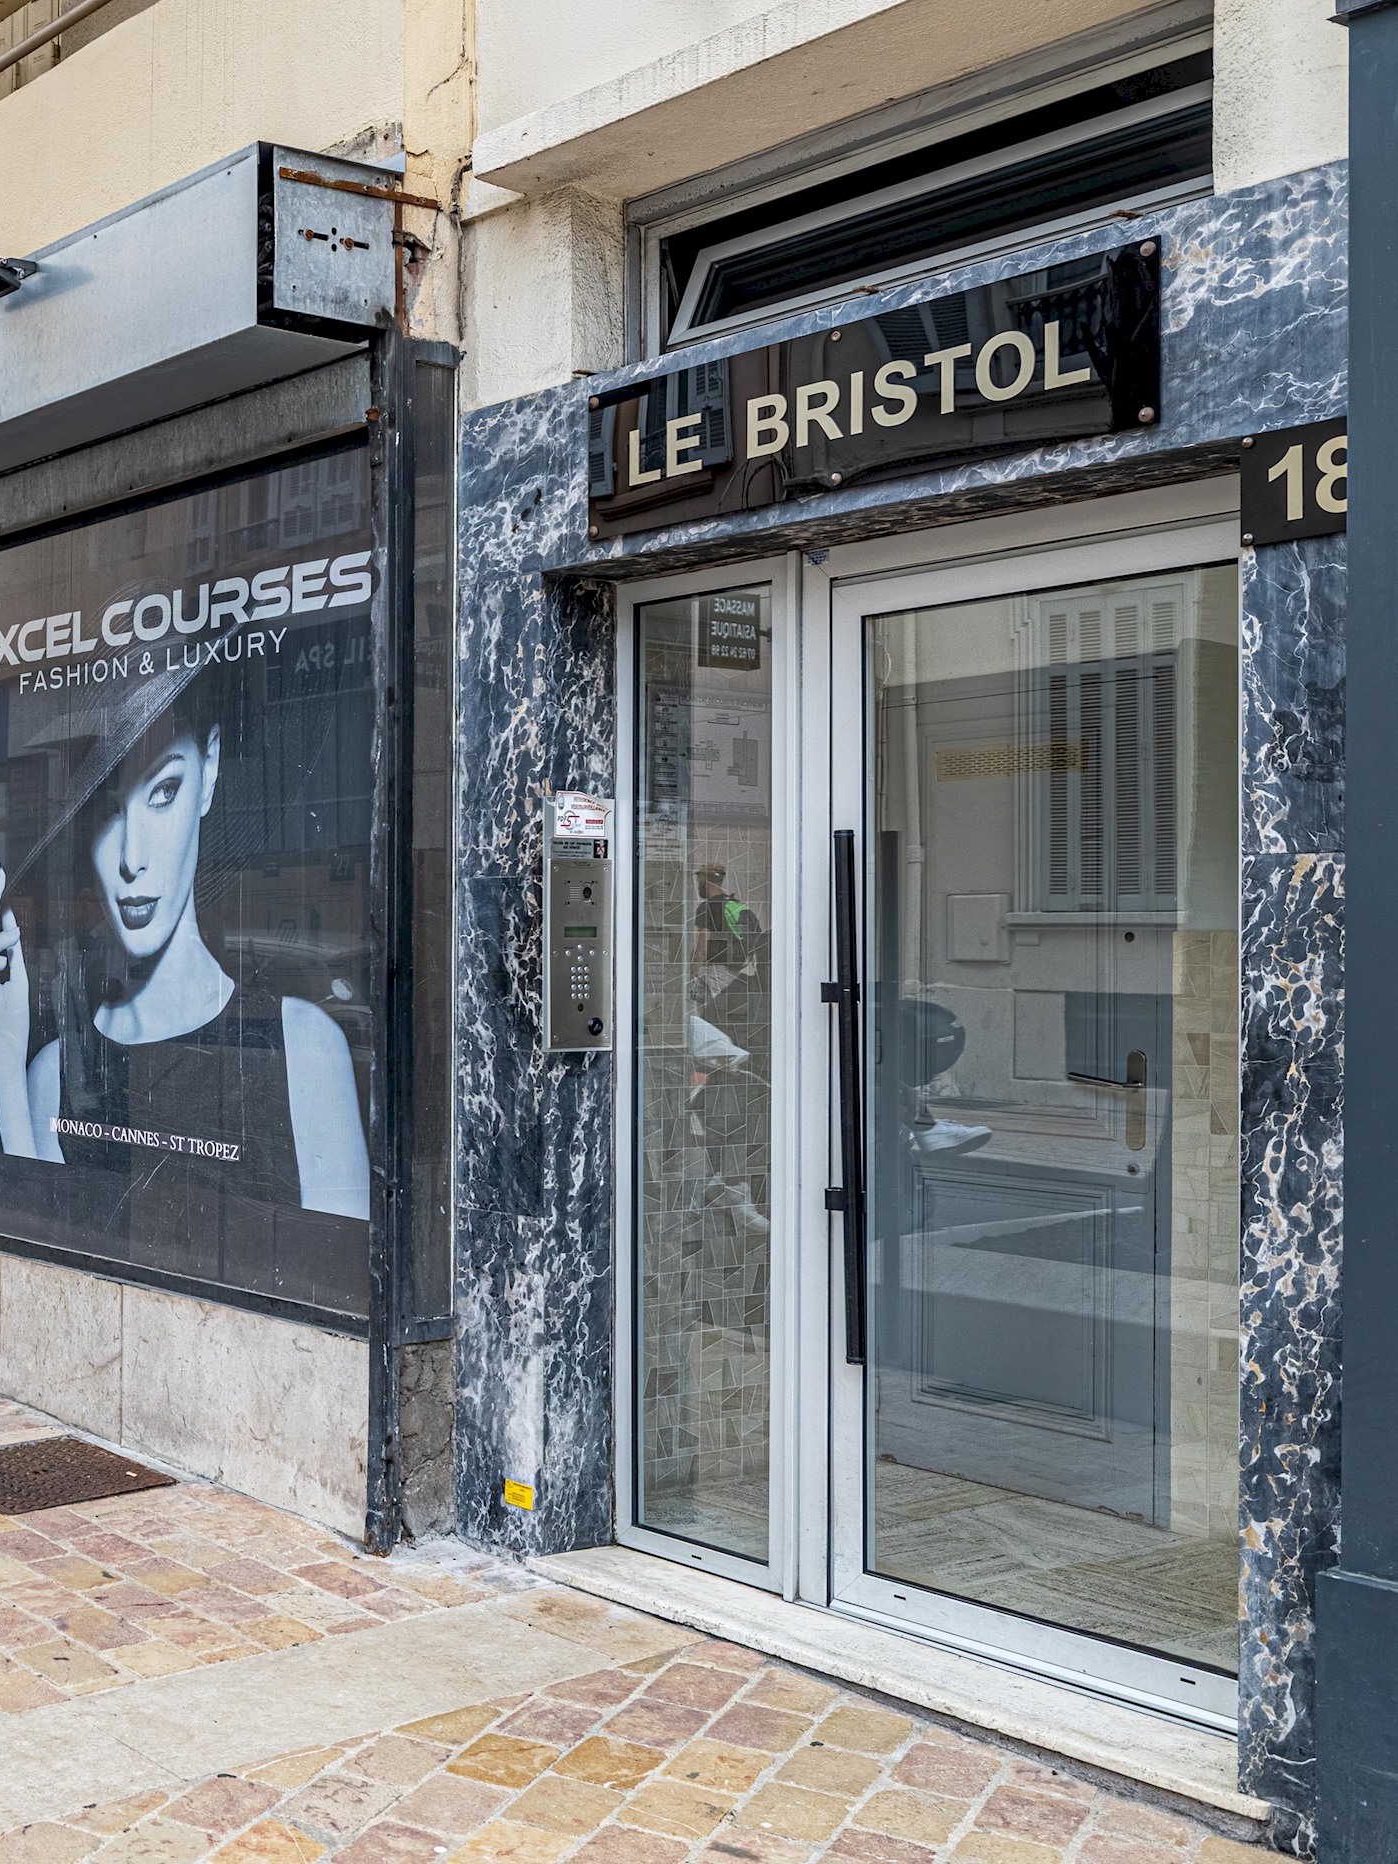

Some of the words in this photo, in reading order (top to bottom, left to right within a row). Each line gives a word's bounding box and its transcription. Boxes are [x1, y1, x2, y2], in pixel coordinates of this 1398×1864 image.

[628, 412, 703, 487] LE
[746, 320, 1091, 460] BRISTOL
[1268, 435, 1348, 521] 18
[102, 550, 372, 648] COURSES
[19, 654, 128, 695] FASHION
[139, 651, 155, 675] &
[166, 627, 288, 672] LUXURY
[51, 1117, 102, 1139] MONACO
[112, 1126, 159, 1147] CANNES
[170, 1135, 186, 1151] ST
[188, 1139, 240, 1161] TROPEZ
